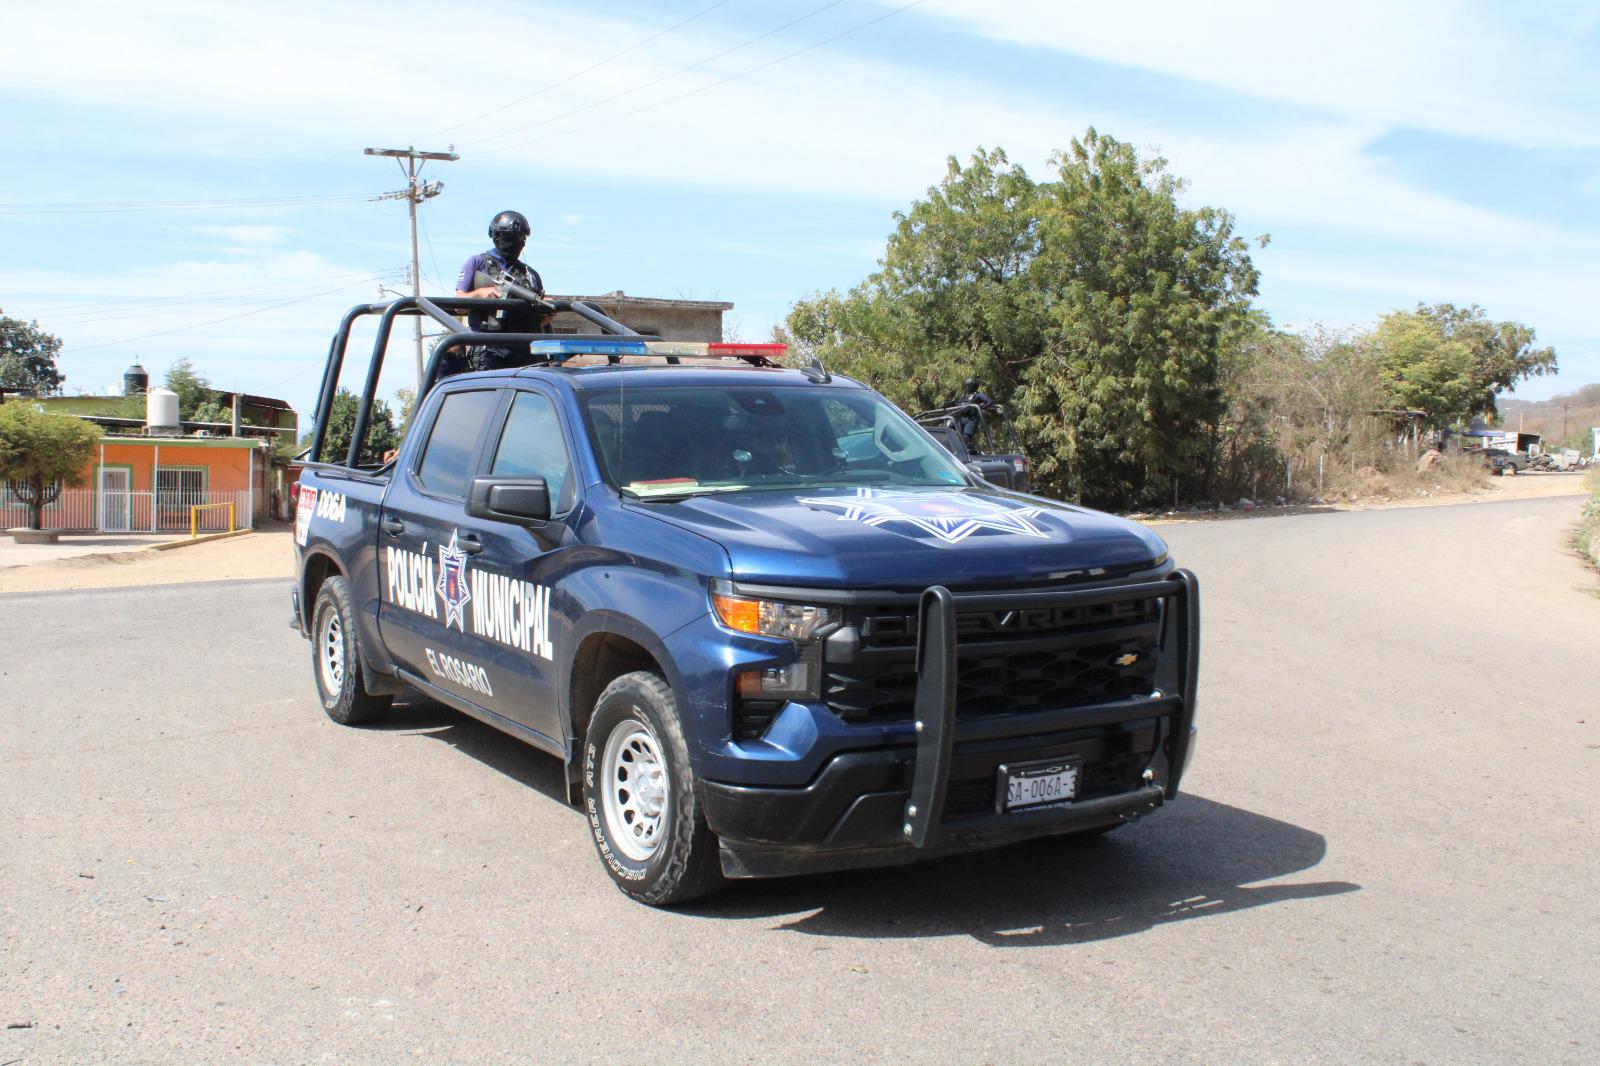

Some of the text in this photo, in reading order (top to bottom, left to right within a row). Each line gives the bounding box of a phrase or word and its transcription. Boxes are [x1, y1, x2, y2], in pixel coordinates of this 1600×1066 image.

[317, 489, 347, 523] 006A
[387, 541, 553, 661] POLICÍA MUNICIPAL
[425, 647, 494, 697] EL ROSARIO
